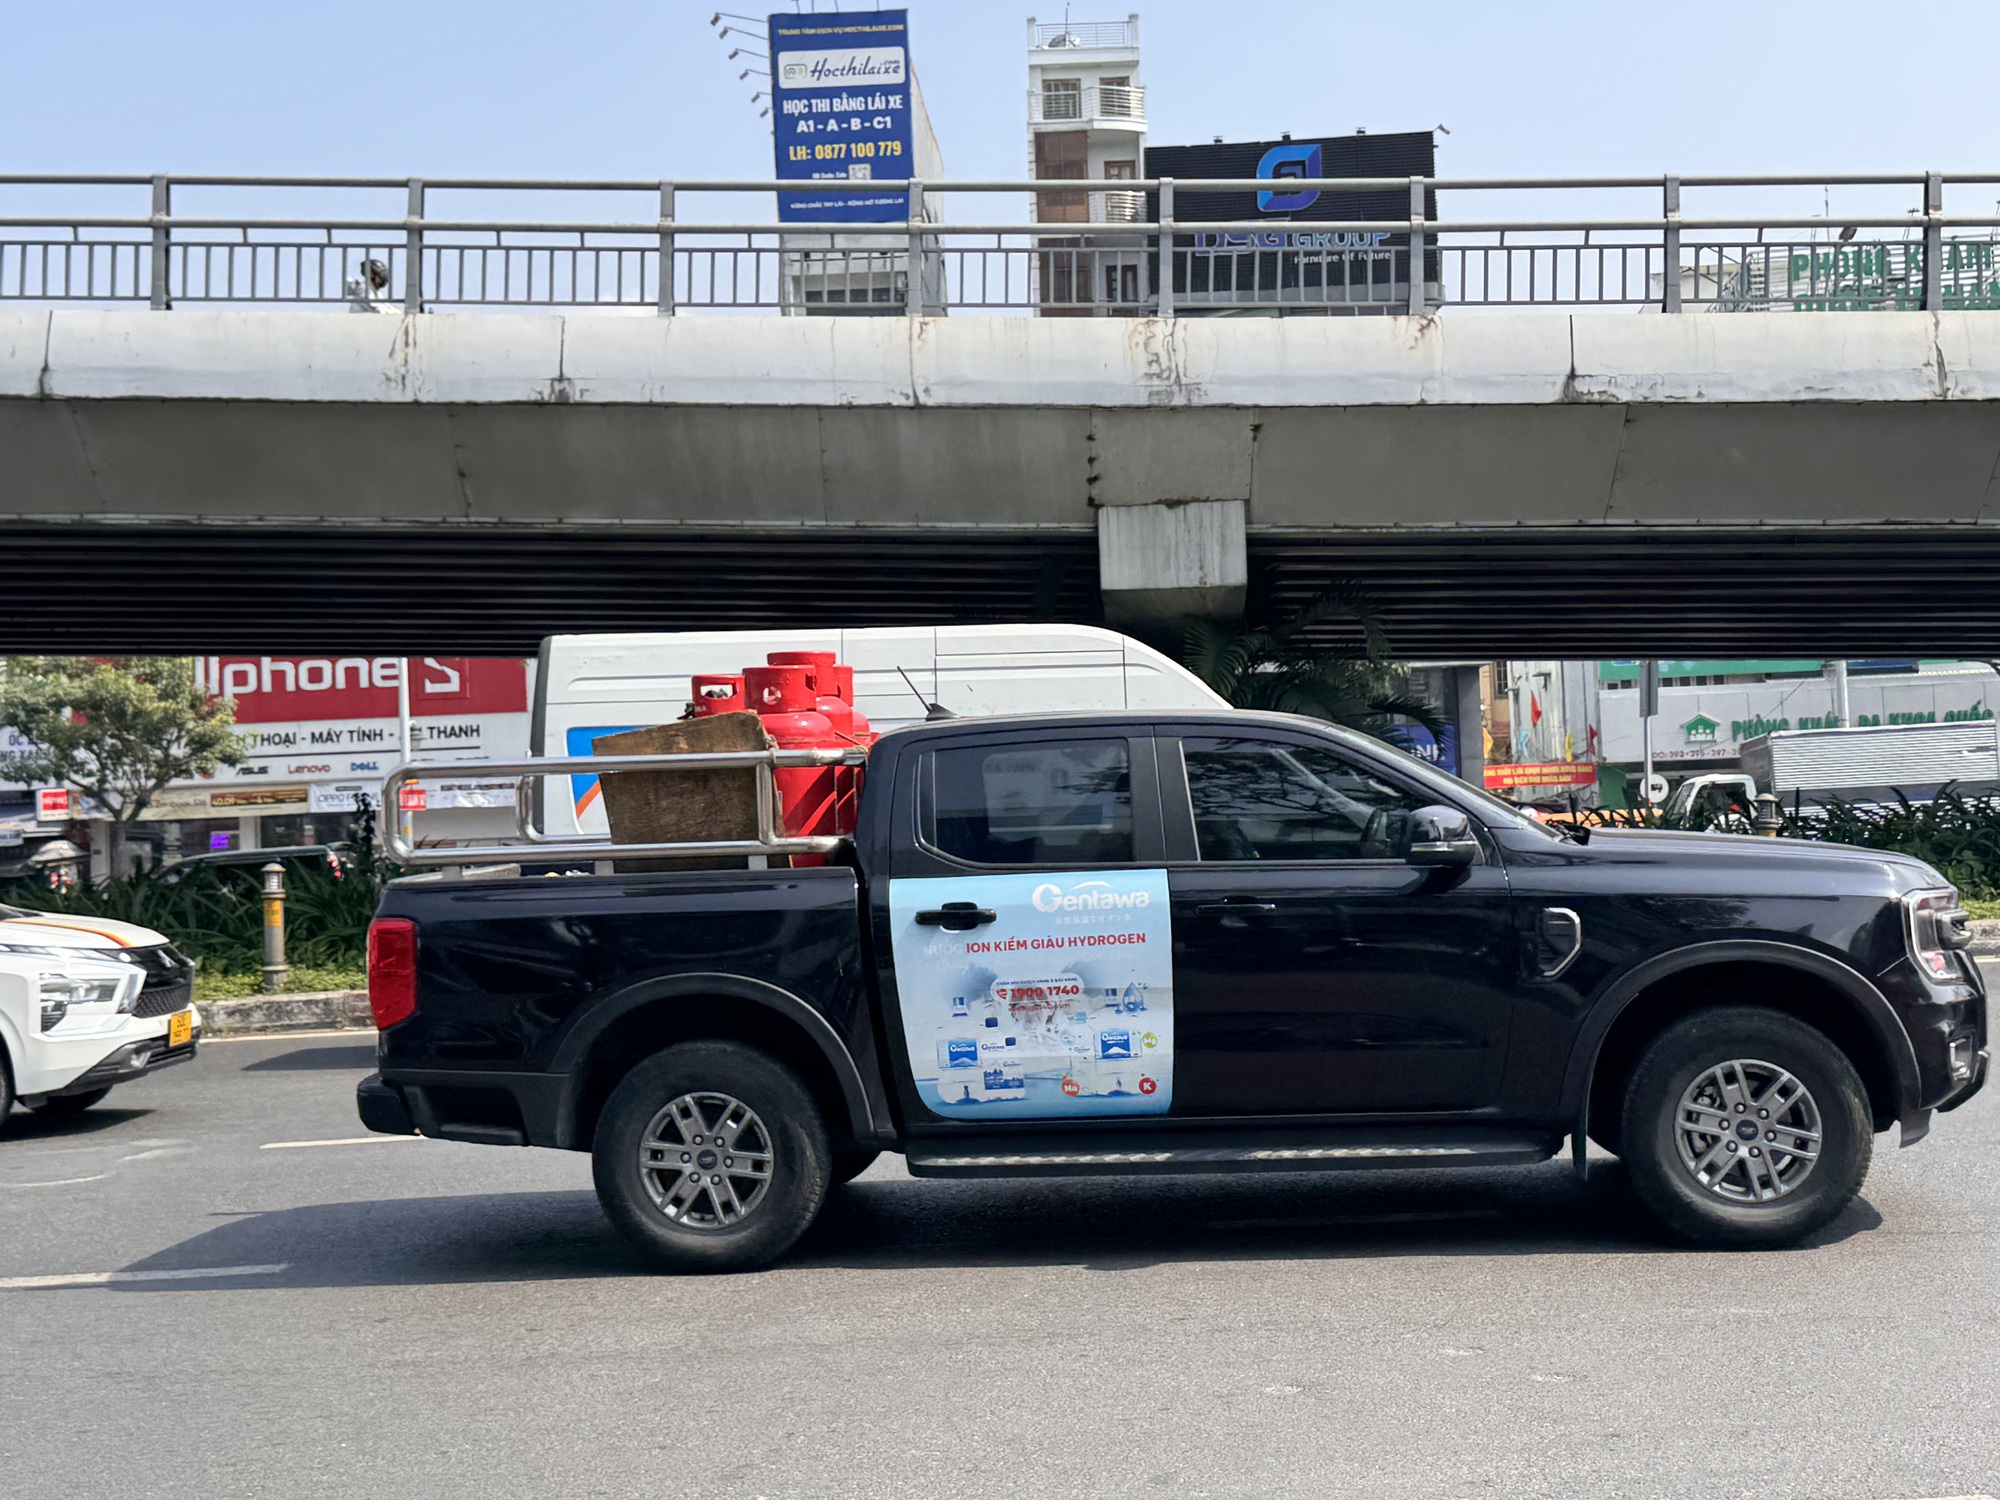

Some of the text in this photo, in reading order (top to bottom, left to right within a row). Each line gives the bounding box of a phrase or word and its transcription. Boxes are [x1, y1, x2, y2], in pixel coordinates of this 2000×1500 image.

[810, 56, 900, 81] Hocthilaixe
[783, 99, 809, 117] HỌC
[810, 98, 831, 113] THI
[867, 92, 886, 110] LÁI
[888, 94, 903, 109] XE
[796, 120, 815, 133] A1
[826, 118, 839, 132] A
[850, 118, 862, 131] B
[872, 116, 892, 129] C1
[789, 140, 902, 161] LH: 0877 100 779
[1292, 233, 1391, 248] GROUP
[252, 732, 297, 748] THOẠI
[311, 728, 343, 744] MÁY
[347, 726, 383, 743] TÍNH
[427, 724, 480, 739] THANH
[236, 762, 378, 775] ASUS Lenovo DELL
[1032, 883, 1149, 912] Gentawa
[966, 942, 990, 954] ION
[1031, 935, 1065, 949] GIÀU
[1068, 933, 1146, 948] HYDROGEN
[1047, 985, 1079, 996] 1740
[1064, 1084, 1078, 1092] Na
[1143, 1082, 1152, 1091] K
